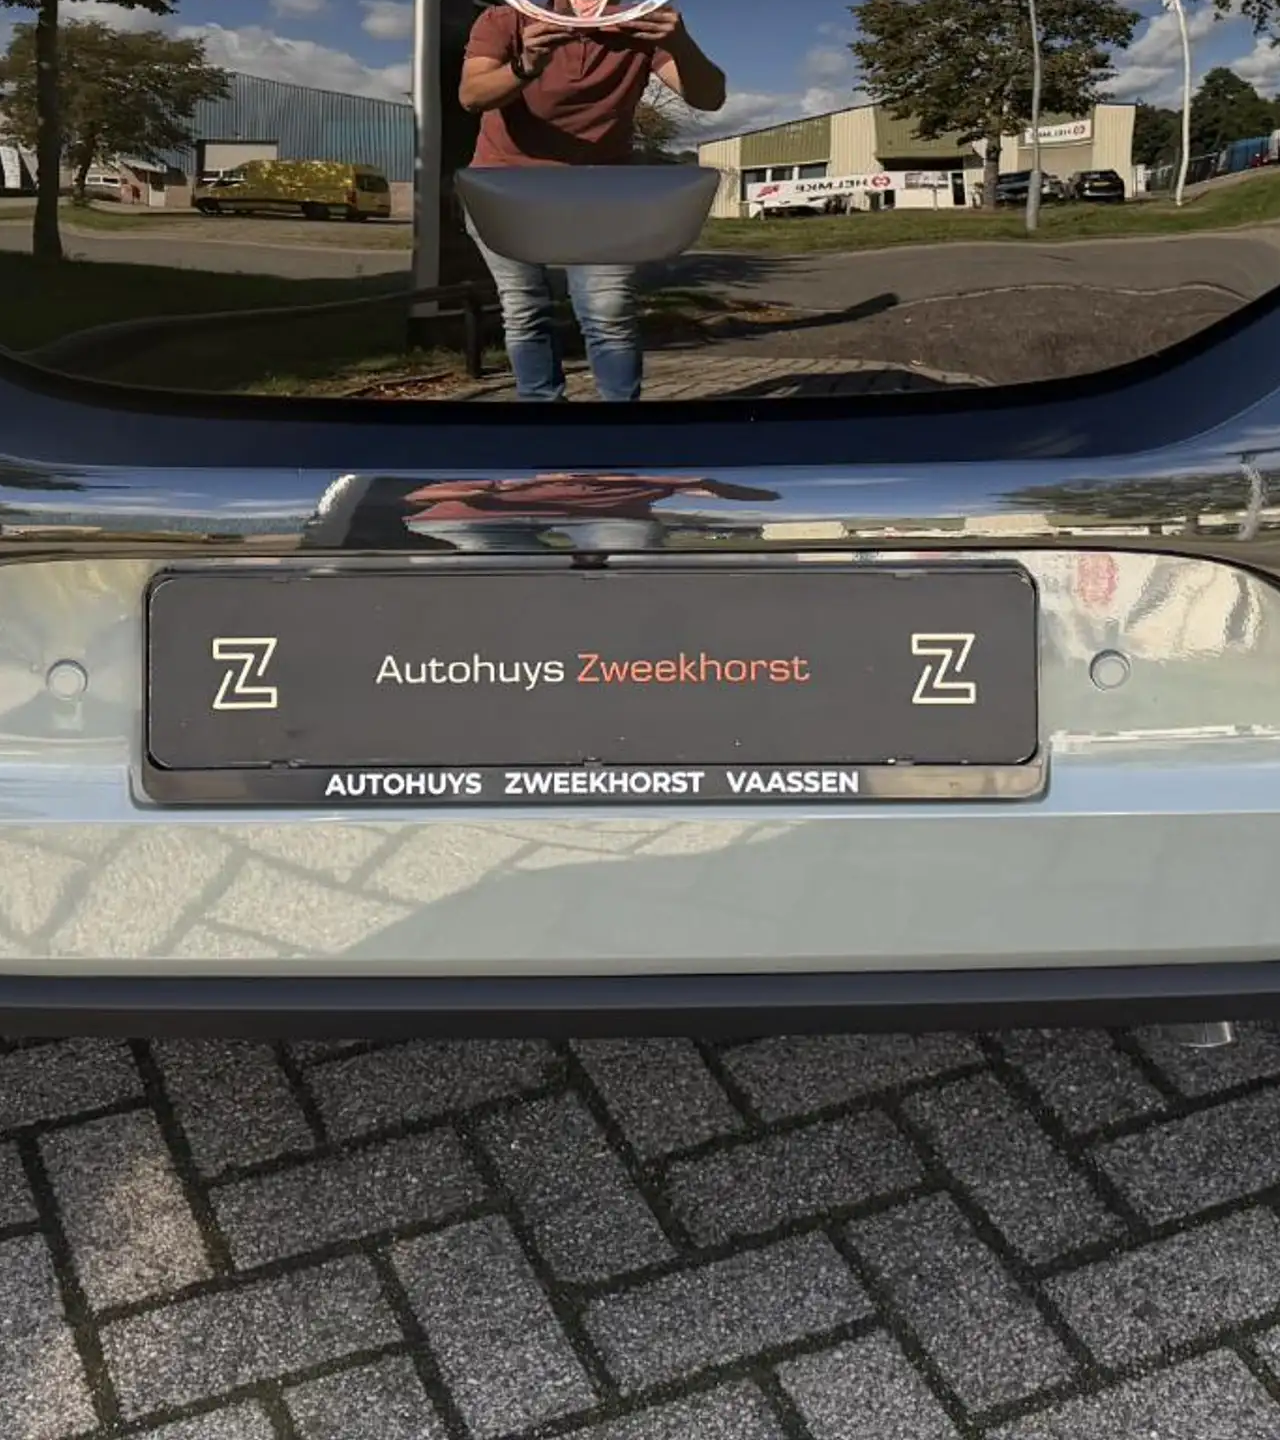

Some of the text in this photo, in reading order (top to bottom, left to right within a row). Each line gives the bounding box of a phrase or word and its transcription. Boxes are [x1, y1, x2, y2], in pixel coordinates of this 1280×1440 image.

[375, 652, 810, 691] Autohuys Zweekhorst
[324, 770, 860, 797] AUTOHUYS ZWEEKHORST VAASSEN
